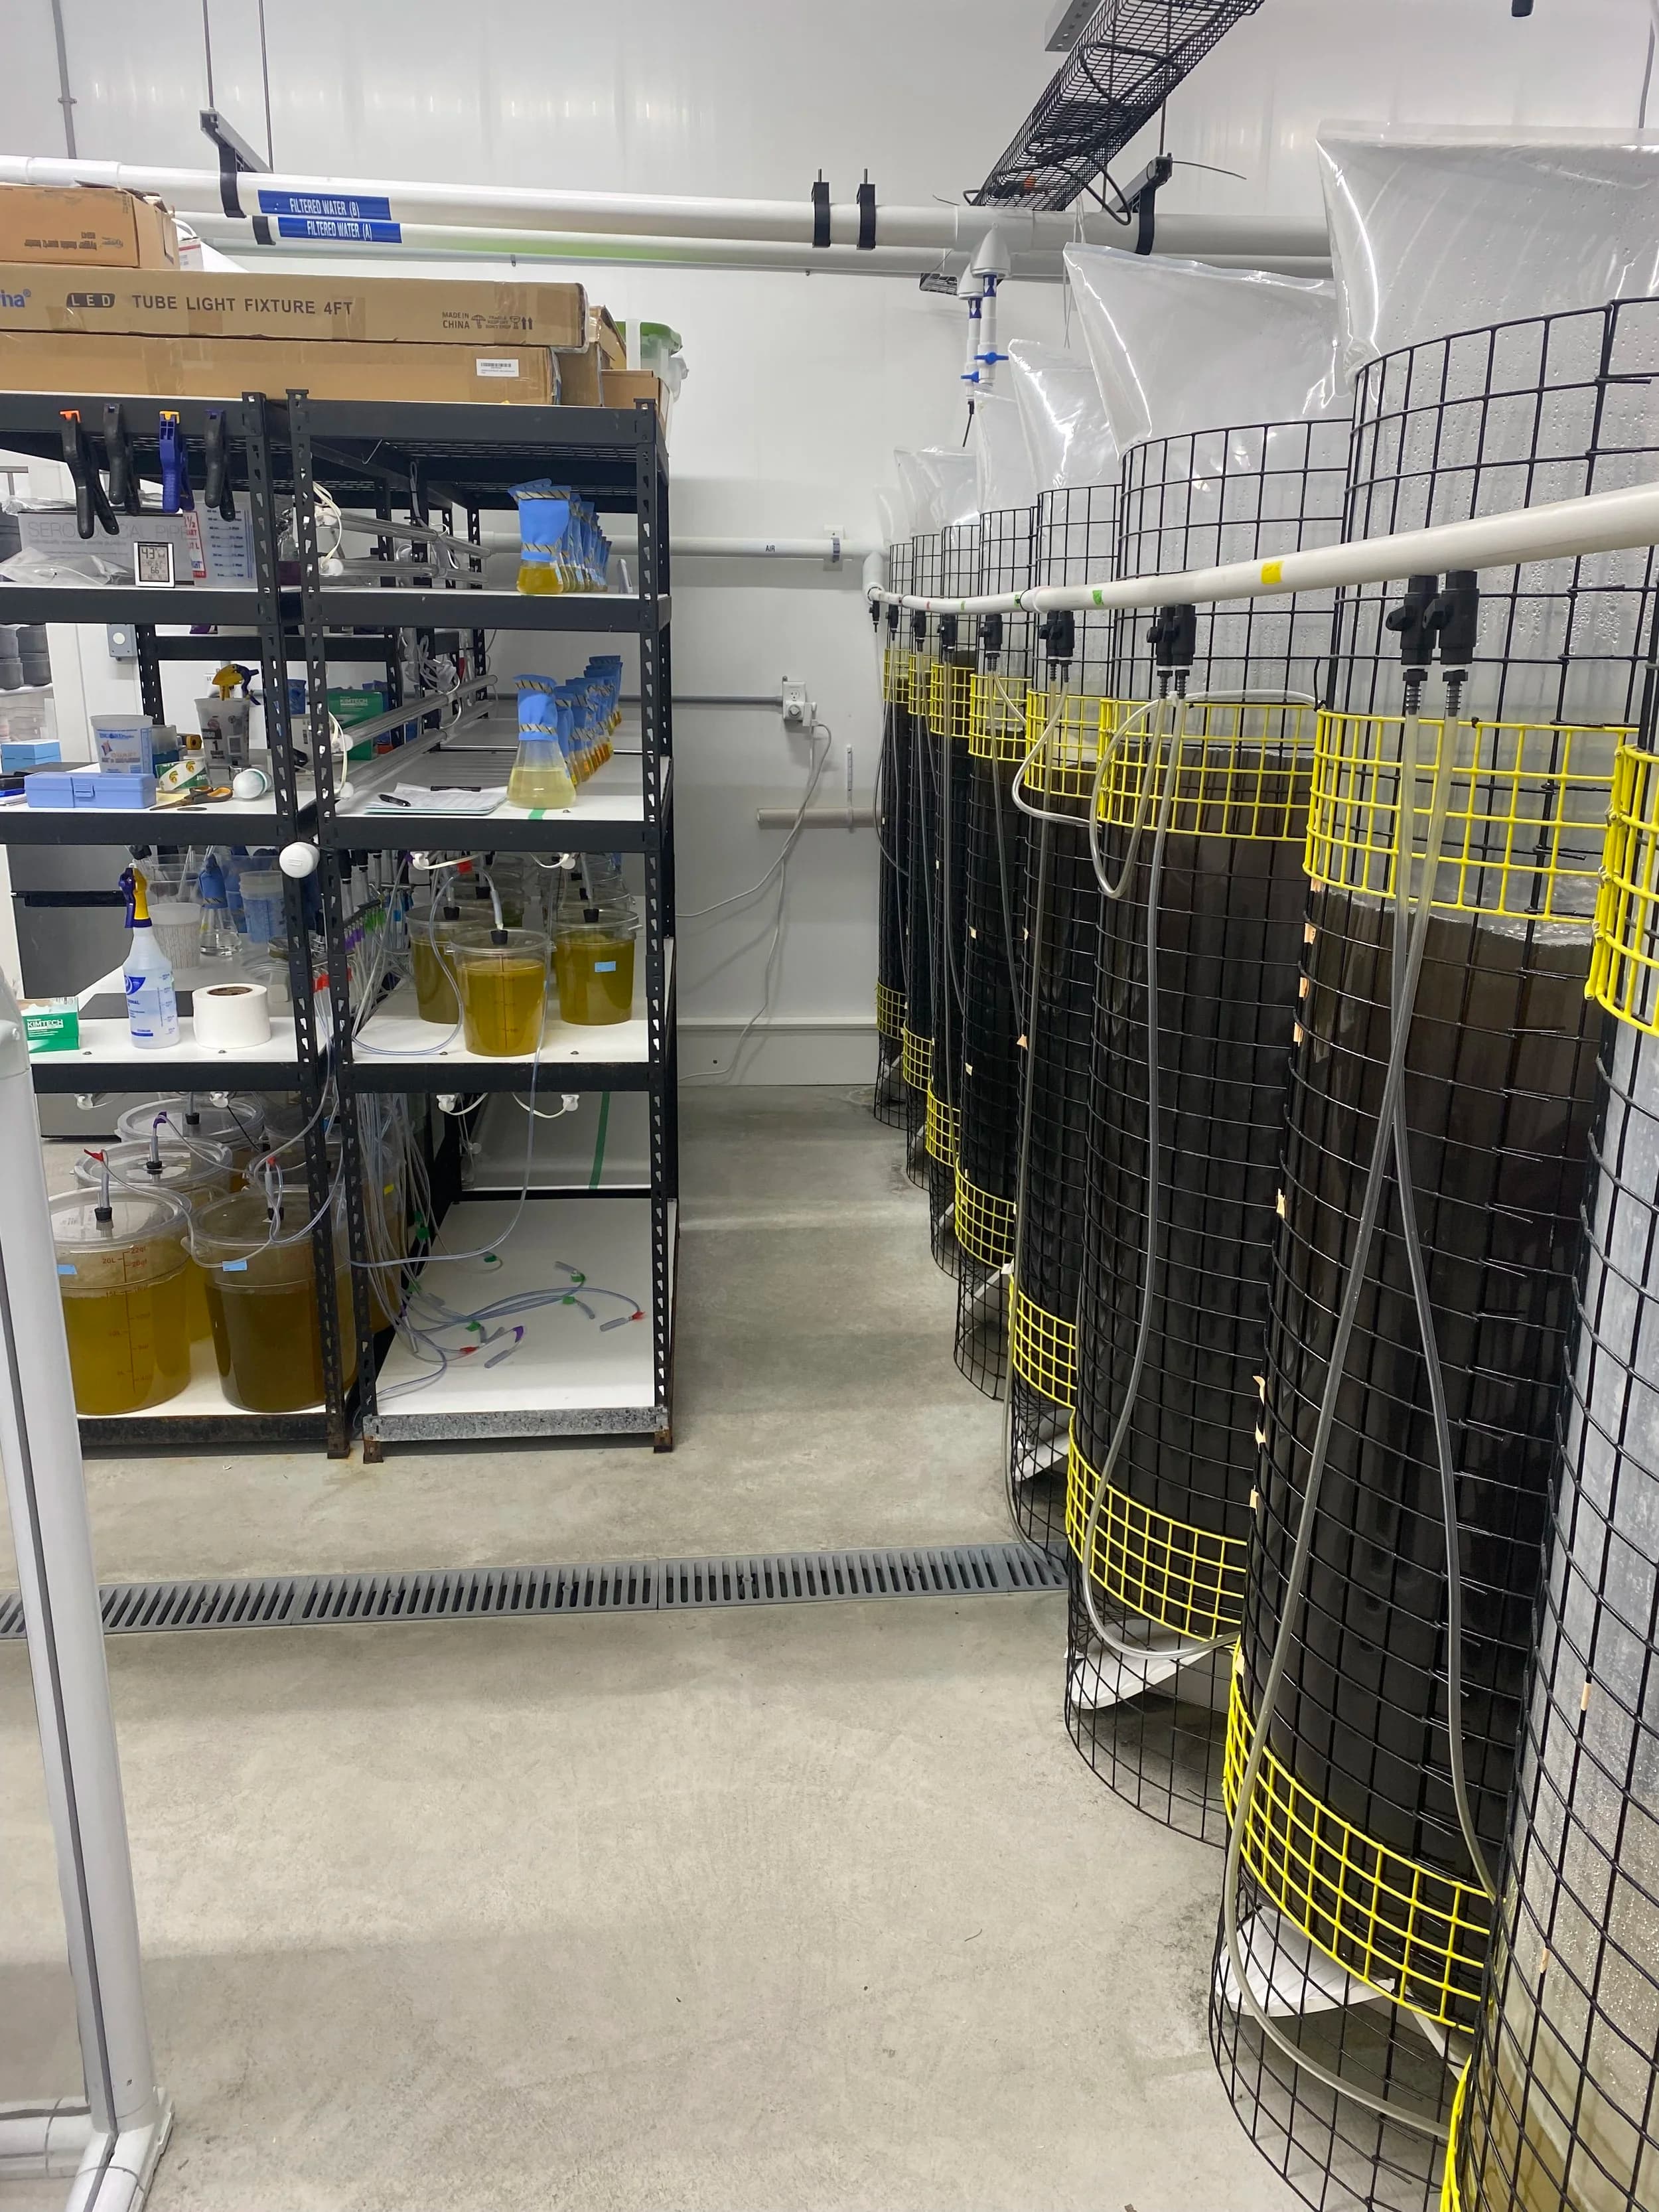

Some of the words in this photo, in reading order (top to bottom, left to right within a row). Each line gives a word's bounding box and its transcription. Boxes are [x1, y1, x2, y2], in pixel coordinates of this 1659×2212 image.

[289, 198, 322, 214] FILTERED
[323, 200, 346, 216] WATER
[349, 201, 360, 218] (B)
[307, 220, 336, 236] FILTERED
[337, 222, 360, 238] WATER
[362, 224, 372, 241] (A)
[70, 294, 111, 307] LED
[132, 294, 177, 309] TUBE
[186, 297, 236, 311] LIGHT
[244, 298, 316, 314] FIXTURE
[323, 301, 353, 315] 4FT
[443, 320, 470, 329] CHINA
[27, 1019, 63, 1029] KIMTECH
